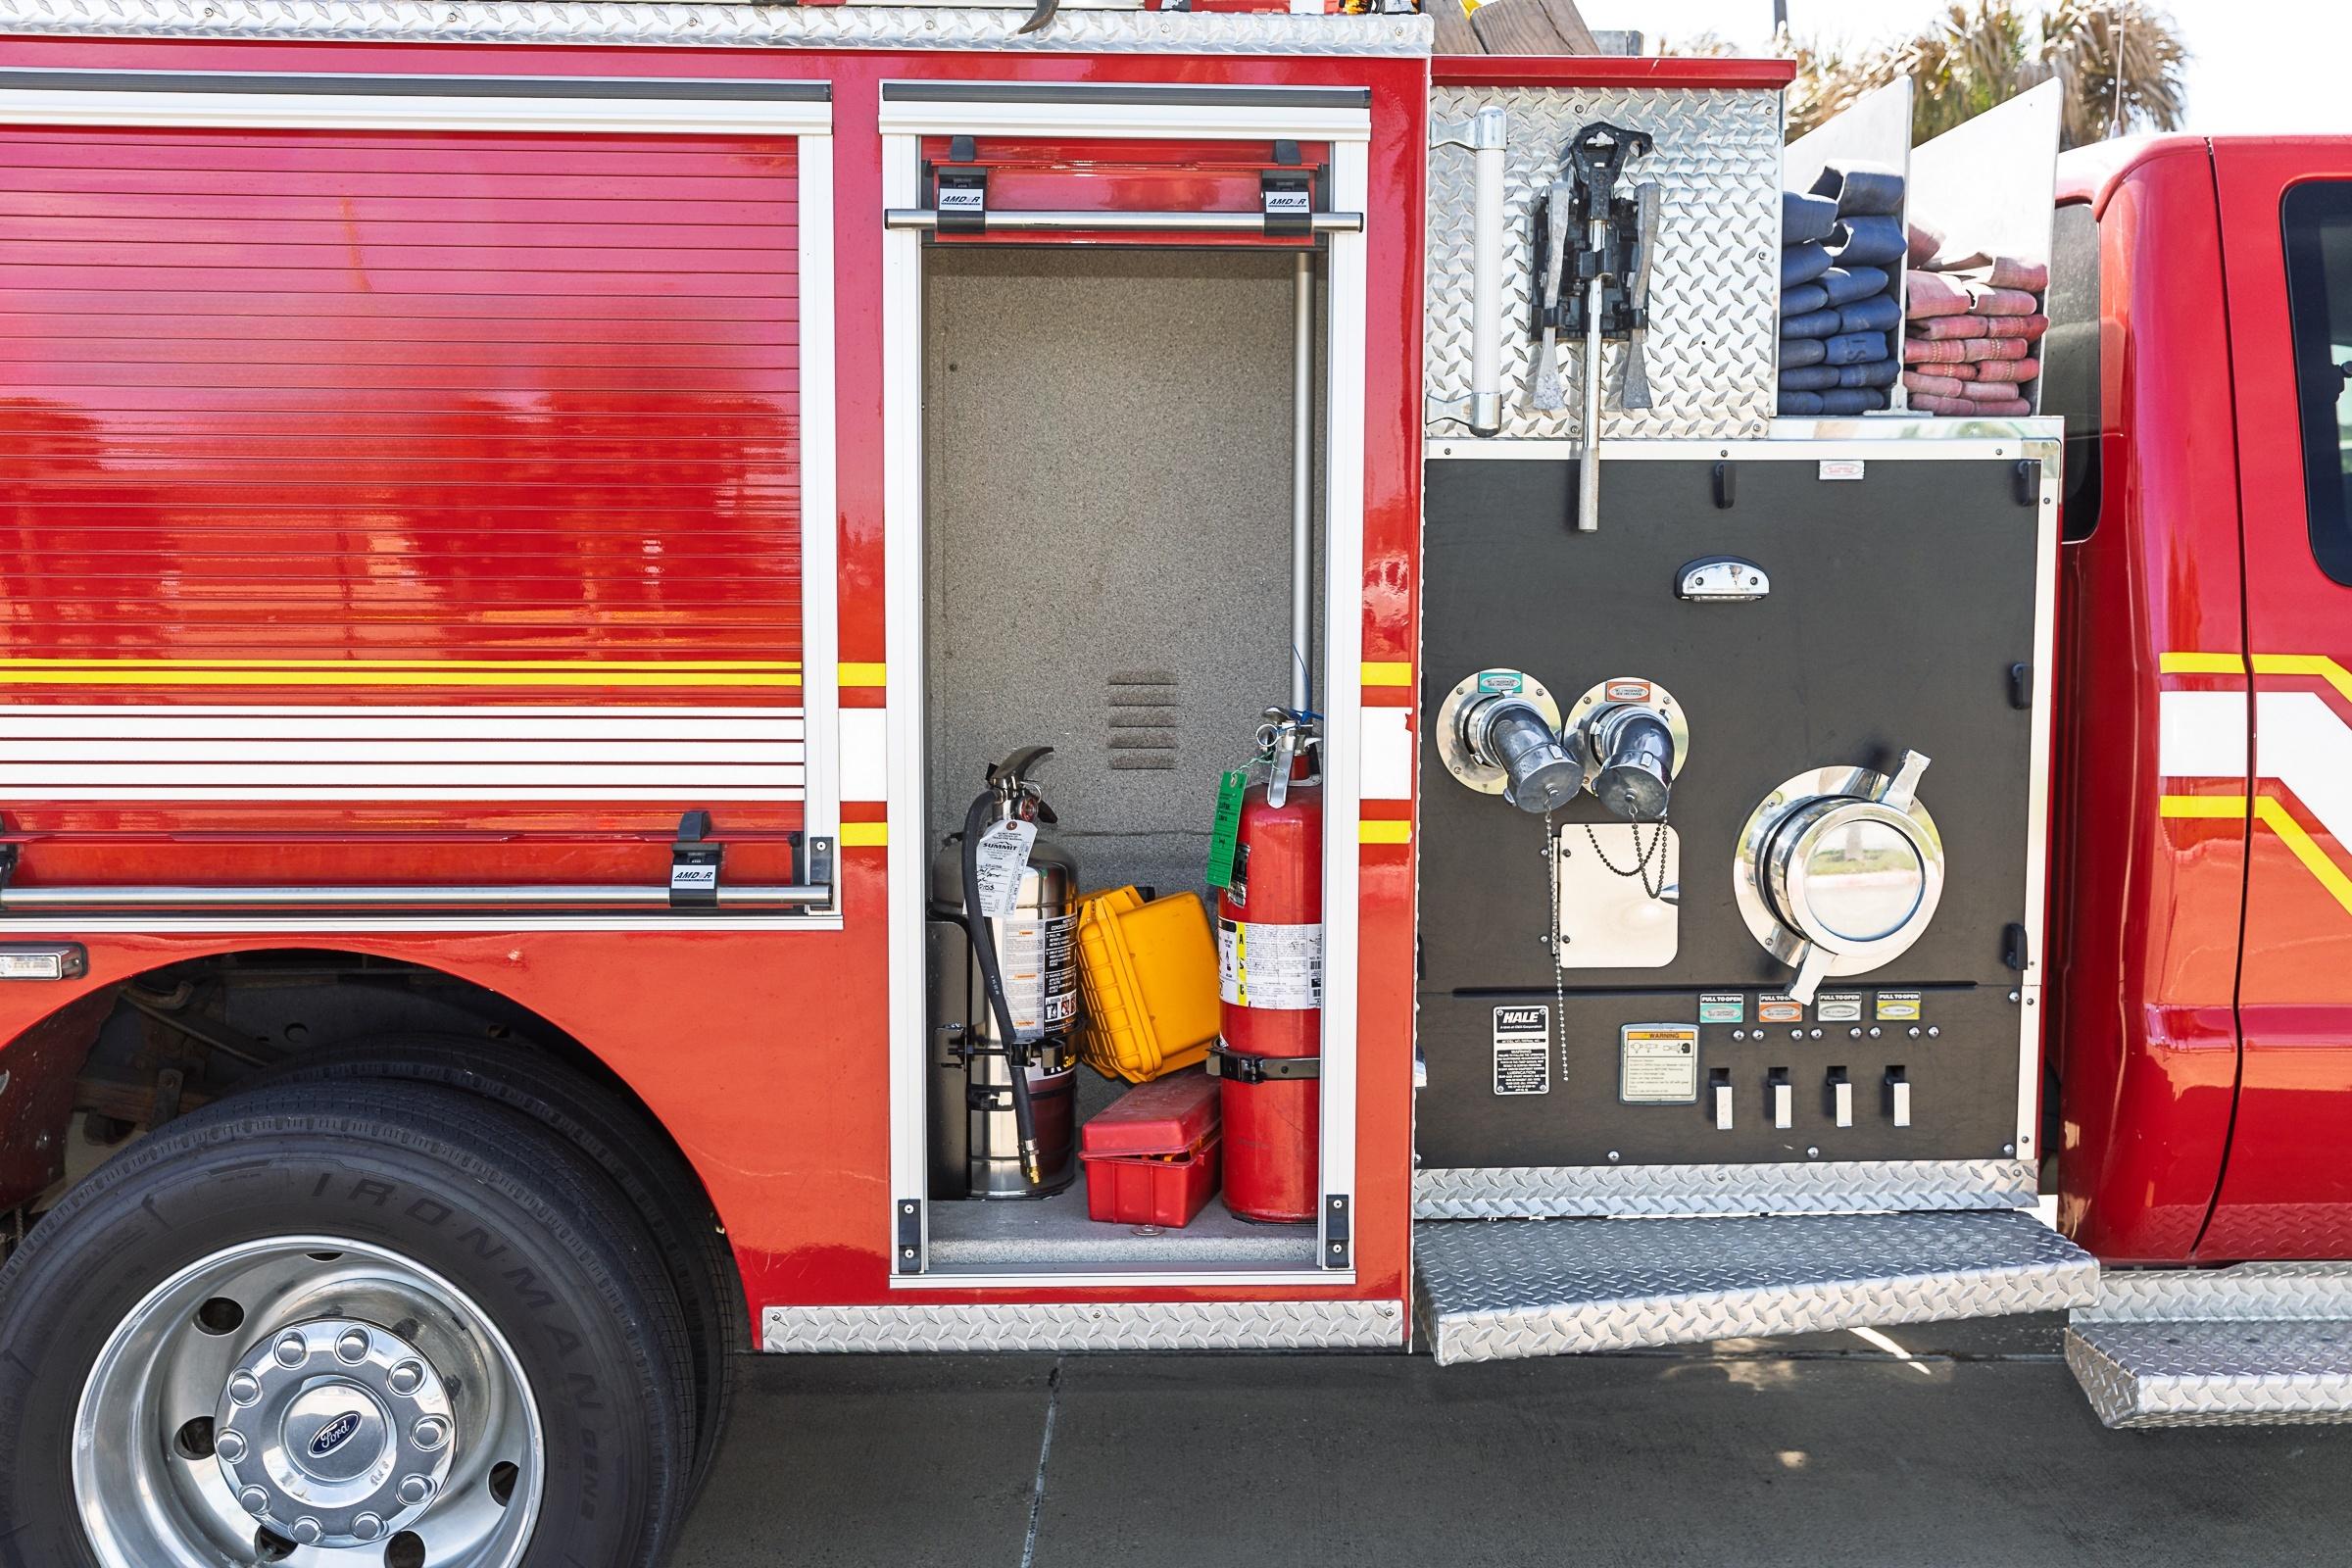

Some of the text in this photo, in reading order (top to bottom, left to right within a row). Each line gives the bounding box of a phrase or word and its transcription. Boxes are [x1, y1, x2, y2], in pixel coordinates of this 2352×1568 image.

[983, 842, 1018, 851] SUMMIT
[1239, 934, 1244, 945] A
[1502, 1011, 1540, 1024] HALE
[311, 1172, 606, 1411] IRONMAN
[319, 1419, 350, 1448] Ford
